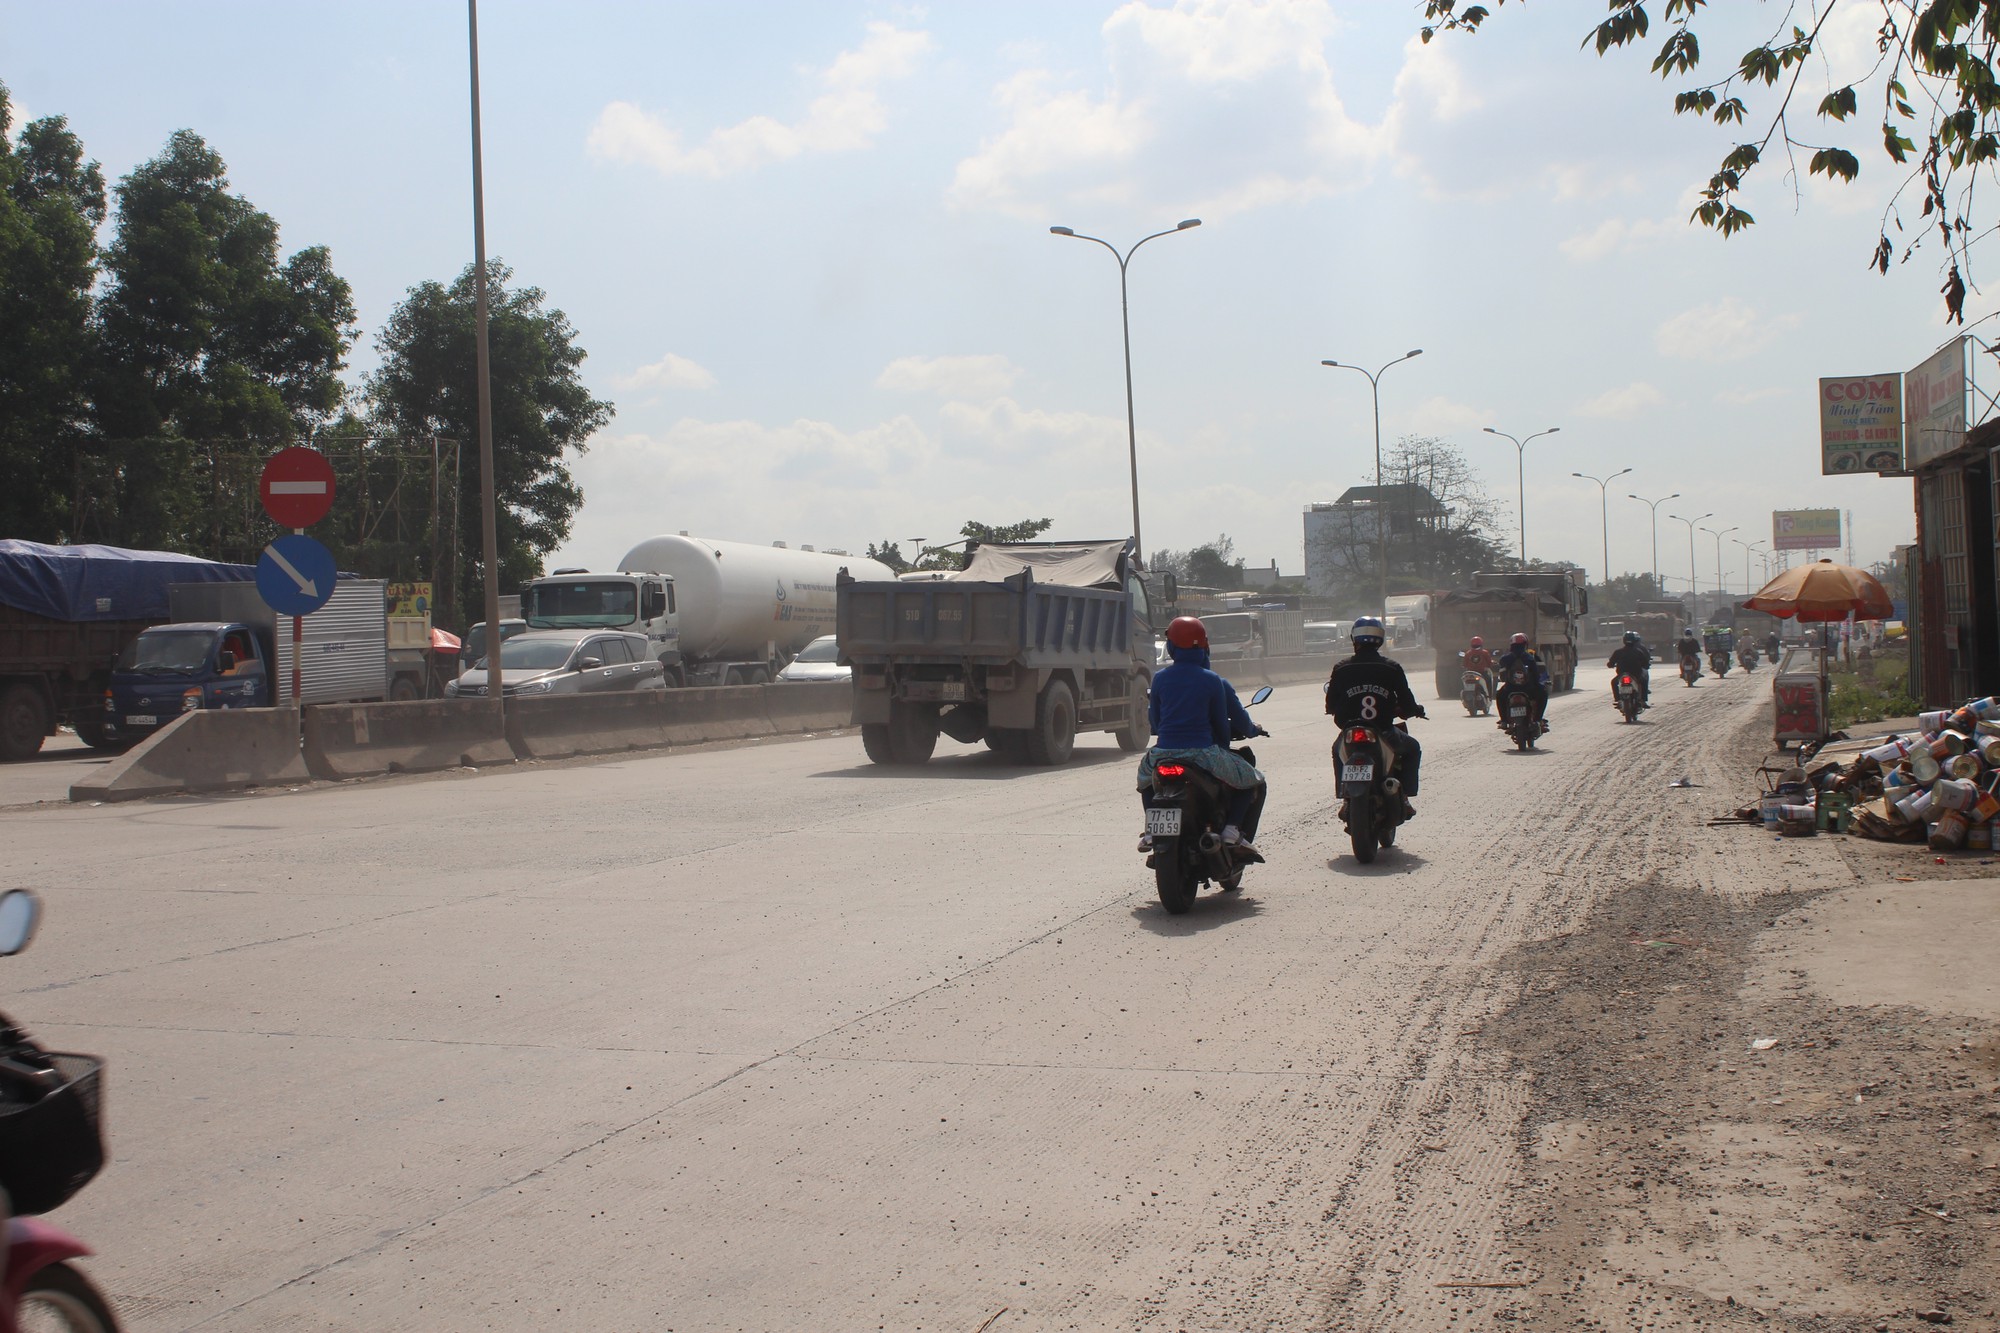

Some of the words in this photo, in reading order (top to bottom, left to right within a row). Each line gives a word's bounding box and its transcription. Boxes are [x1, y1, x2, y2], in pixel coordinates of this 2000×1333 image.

[1346, 684, 1390, 699] HILFIGER
[1361, 695, 1378, 720] 8
[1147, 822, 1179, 834] 508.59
